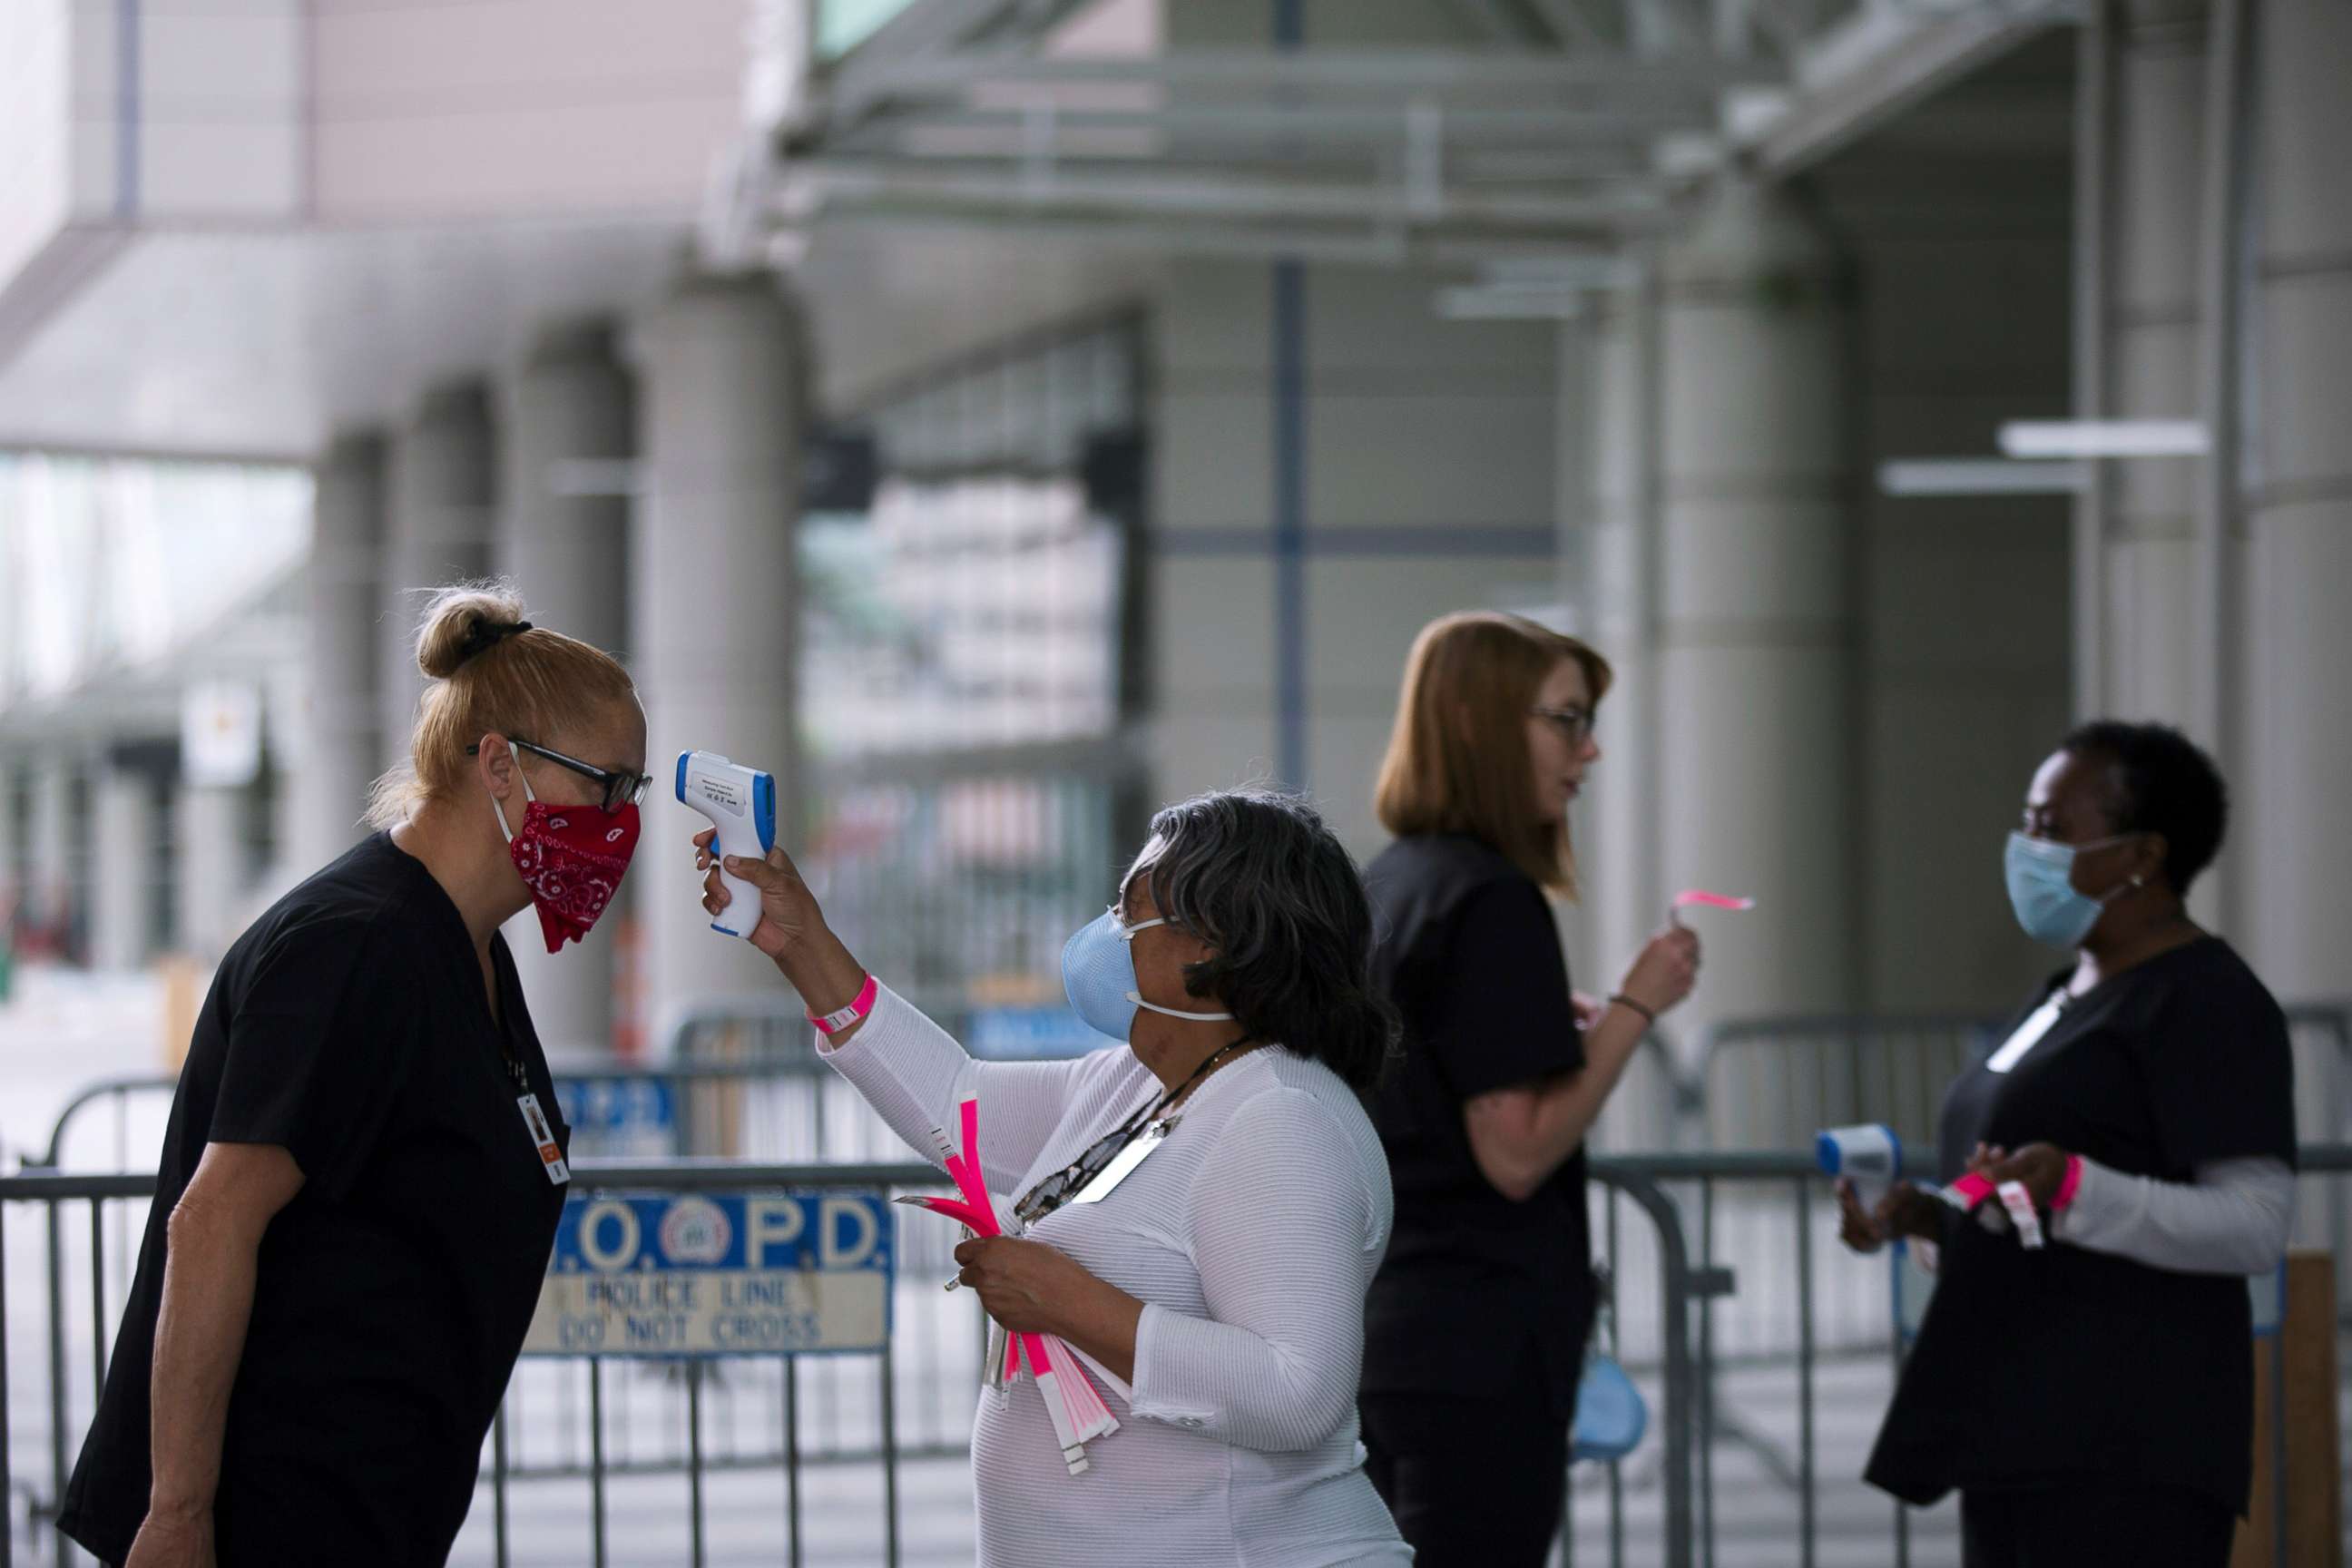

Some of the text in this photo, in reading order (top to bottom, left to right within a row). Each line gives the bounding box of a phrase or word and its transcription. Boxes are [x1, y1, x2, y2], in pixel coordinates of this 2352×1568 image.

[555, 1200, 655, 1271] .O.
[588, 1277, 789, 1309] POLICE LINE
[559, 1313, 821, 1348] DO NOT CROSS
